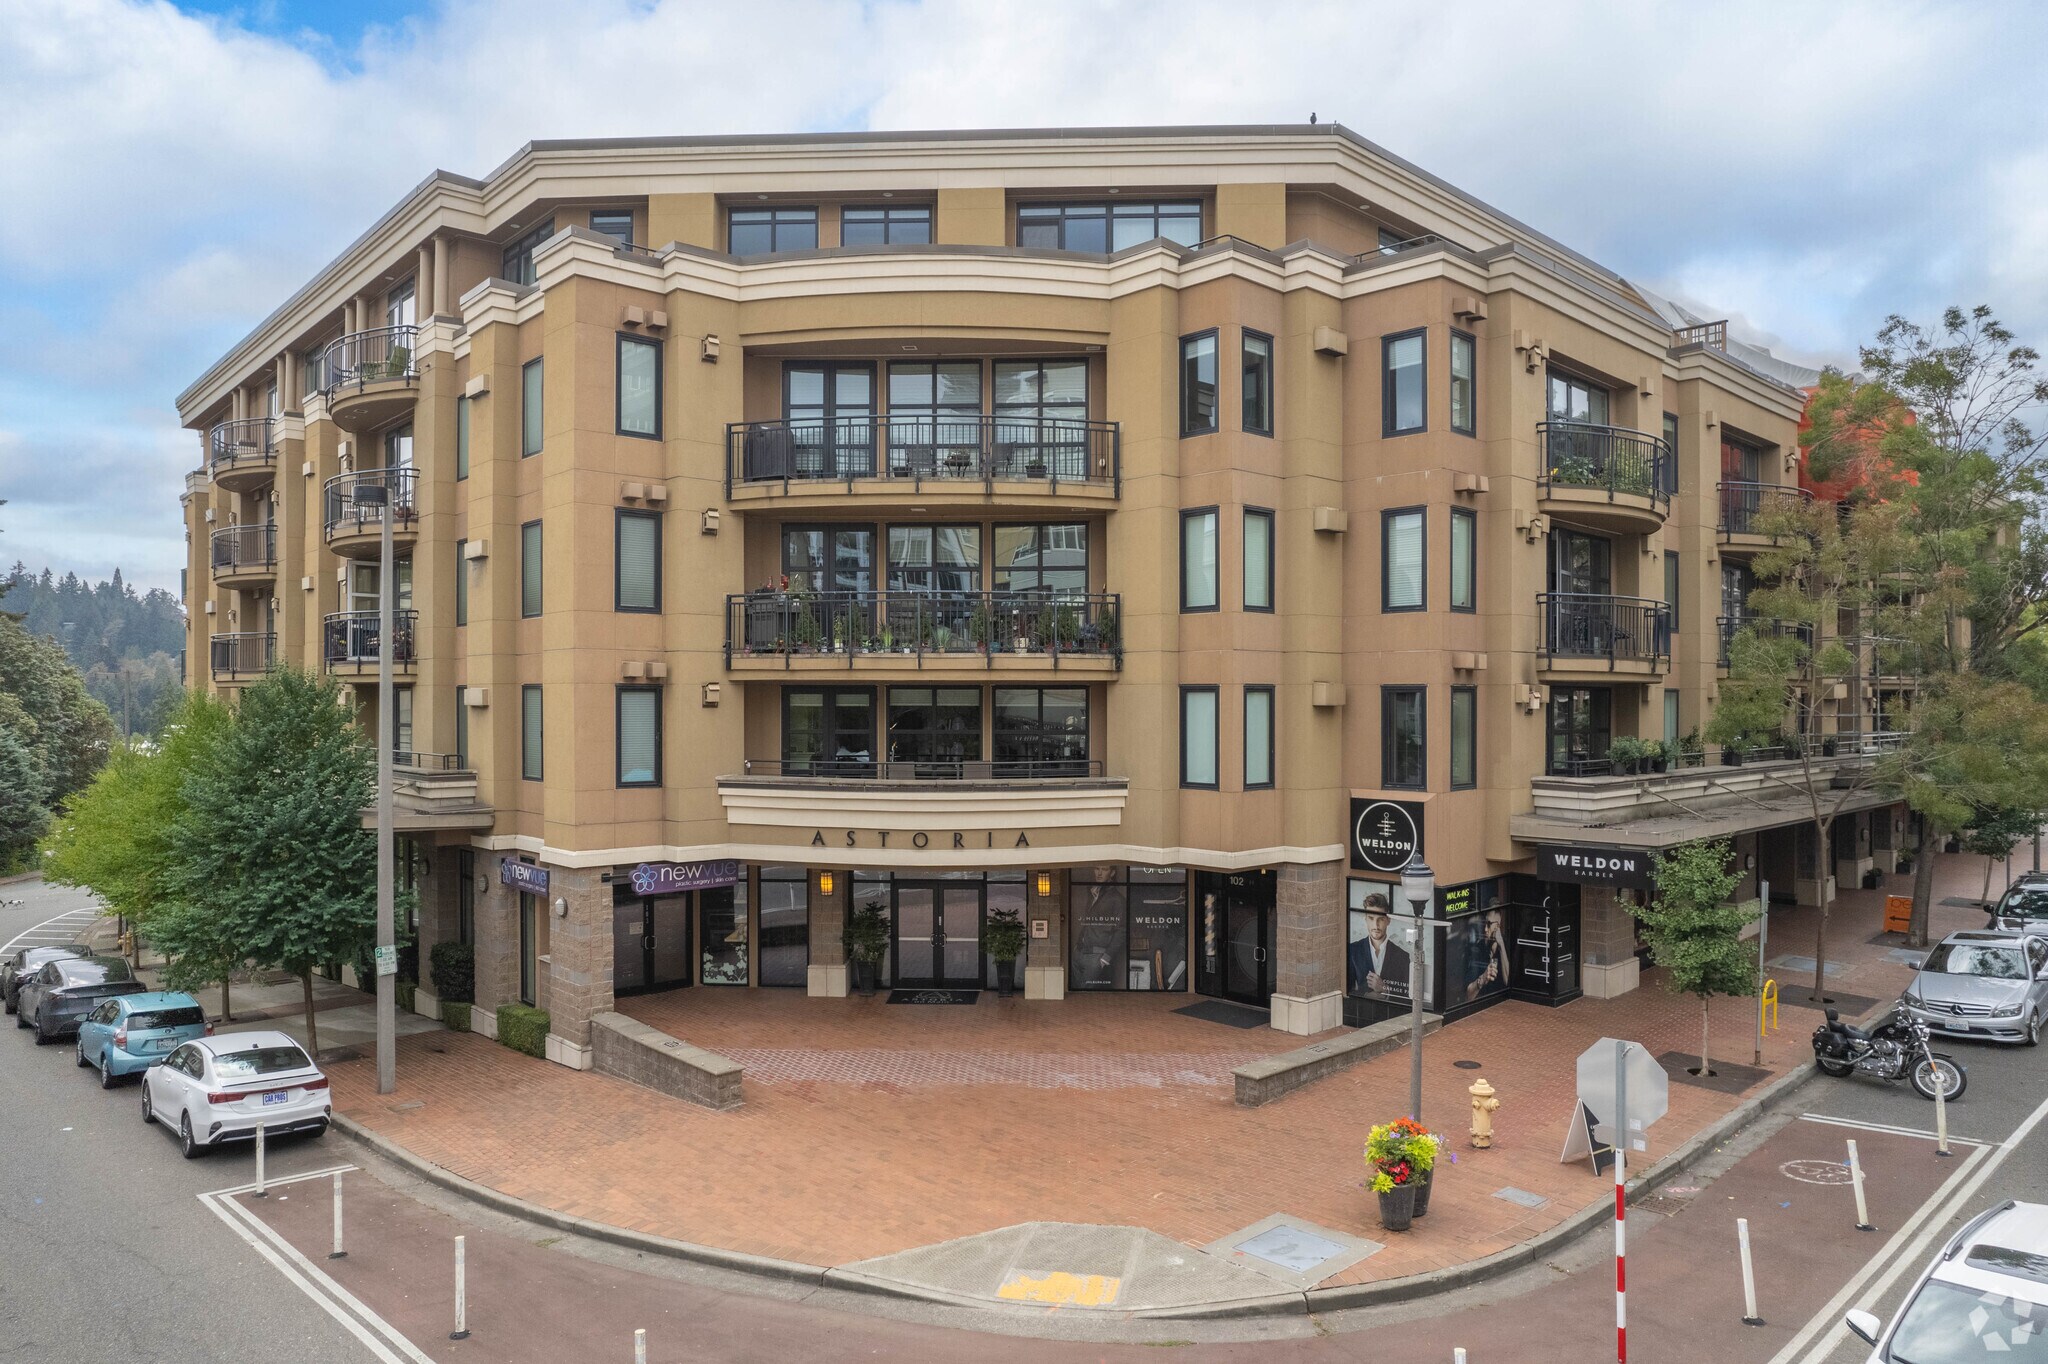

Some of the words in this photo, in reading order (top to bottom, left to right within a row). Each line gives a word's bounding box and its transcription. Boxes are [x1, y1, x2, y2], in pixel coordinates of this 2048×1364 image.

[811, 830, 1030, 848] ASTORIA
[1361, 838, 1412, 851] WELDON
[1554, 854, 1635, 872] WELDON
[511, 864, 547, 886] newvue
[661, 861, 737, 881] newvue
[1574, 869, 1614, 879] BARBER
[675, 880, 692, 888] plastic
[692, 878, 711, 887] surgery
[1229, 876, 1245, 886] 102
[1445, 900, 1469, 912] WELCOME
[1135, 916, 1180, 925] WELDON
[1382, 985, 1403, 994] GARAGE
[264, 1095, 274, 1104] CAR
[274, 1092, 287, 1102] PROS
